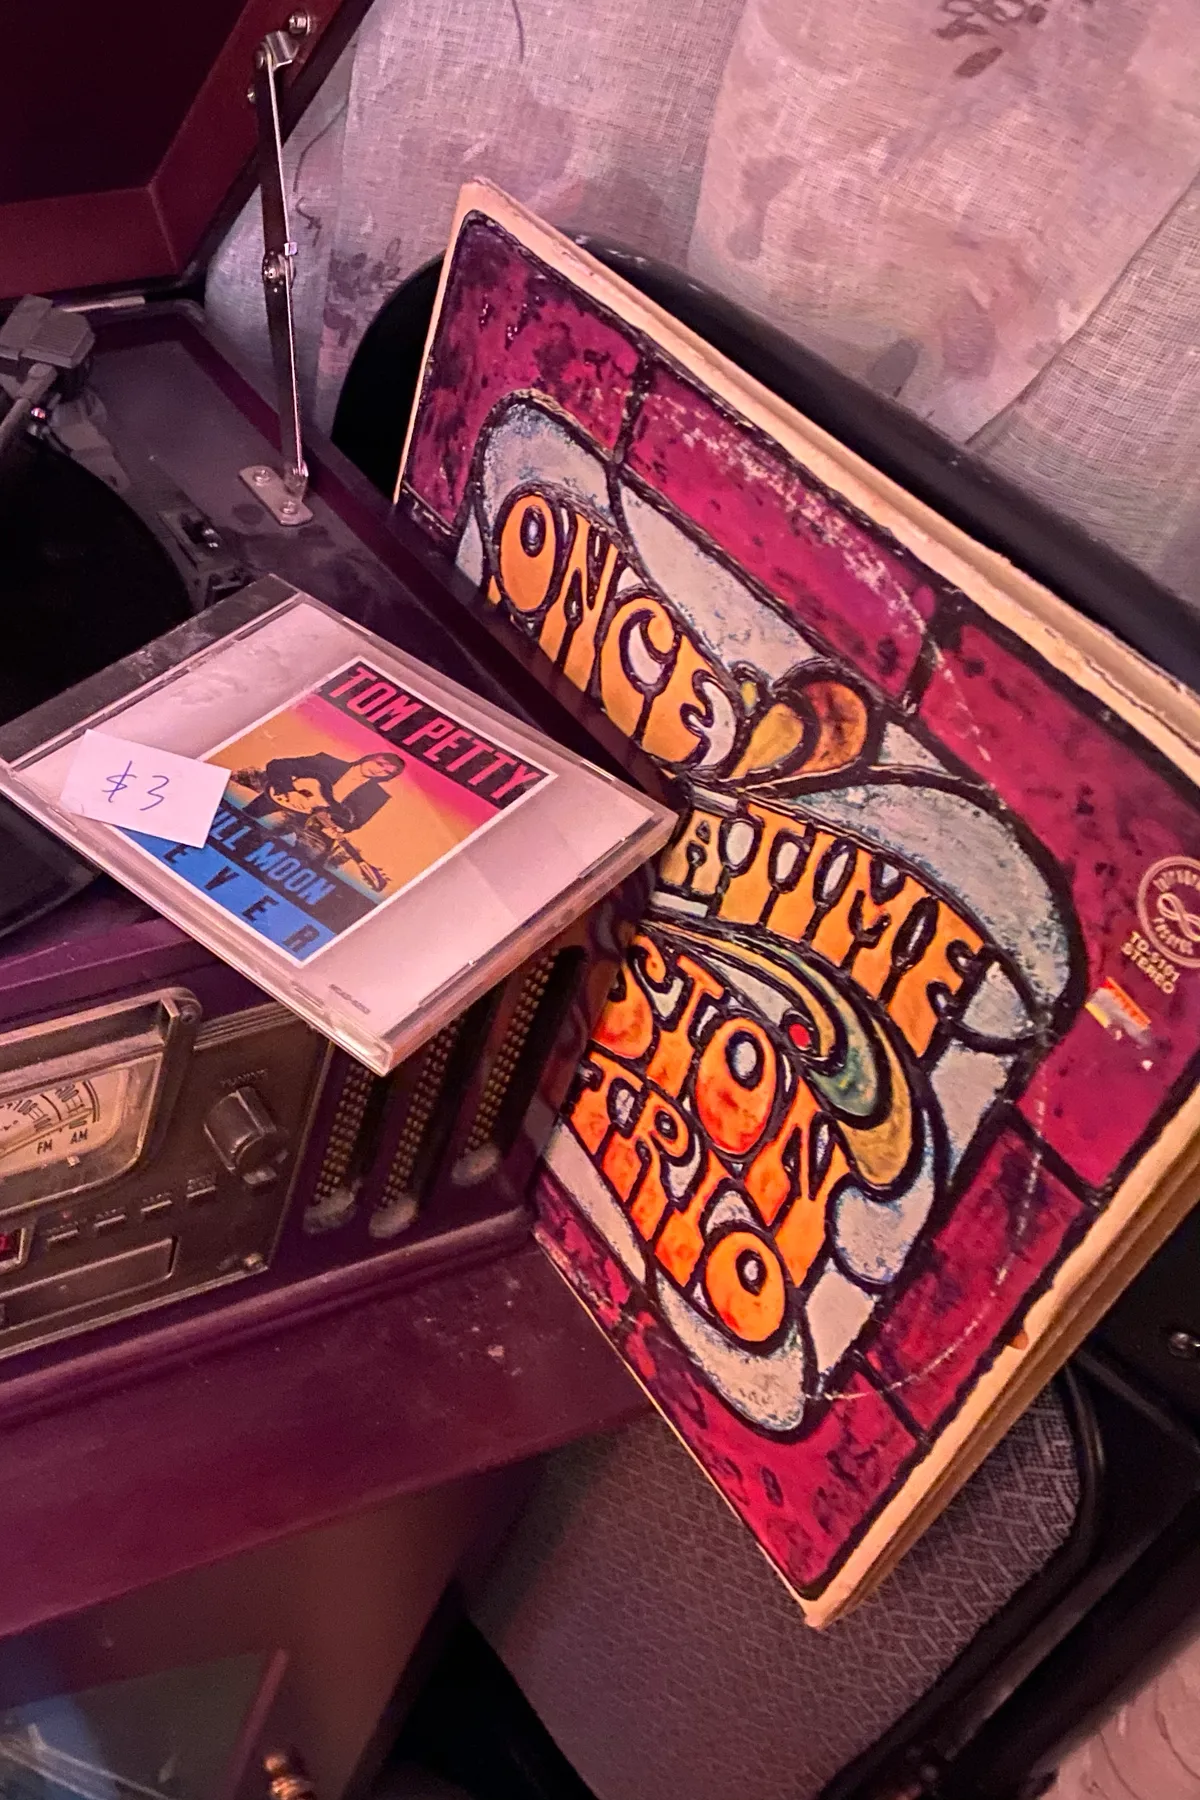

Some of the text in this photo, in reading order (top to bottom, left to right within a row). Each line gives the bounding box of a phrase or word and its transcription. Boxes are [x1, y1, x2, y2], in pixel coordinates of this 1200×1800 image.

[498, 494, 718, 765] ONCE
[328, 665, 541, 800] TOM PETTY
[100, 760, 170, 811] $3
[162, 843, 321, 953] EVER
[209, 804, 337, 905] ULL MOON
[1120, 942, 1176, 995] STEREO
[36, 1139, 54, 1155] FM
[69, 1128, 89, 1145] AM
[574, 1050, 786, 1344] TRIO
